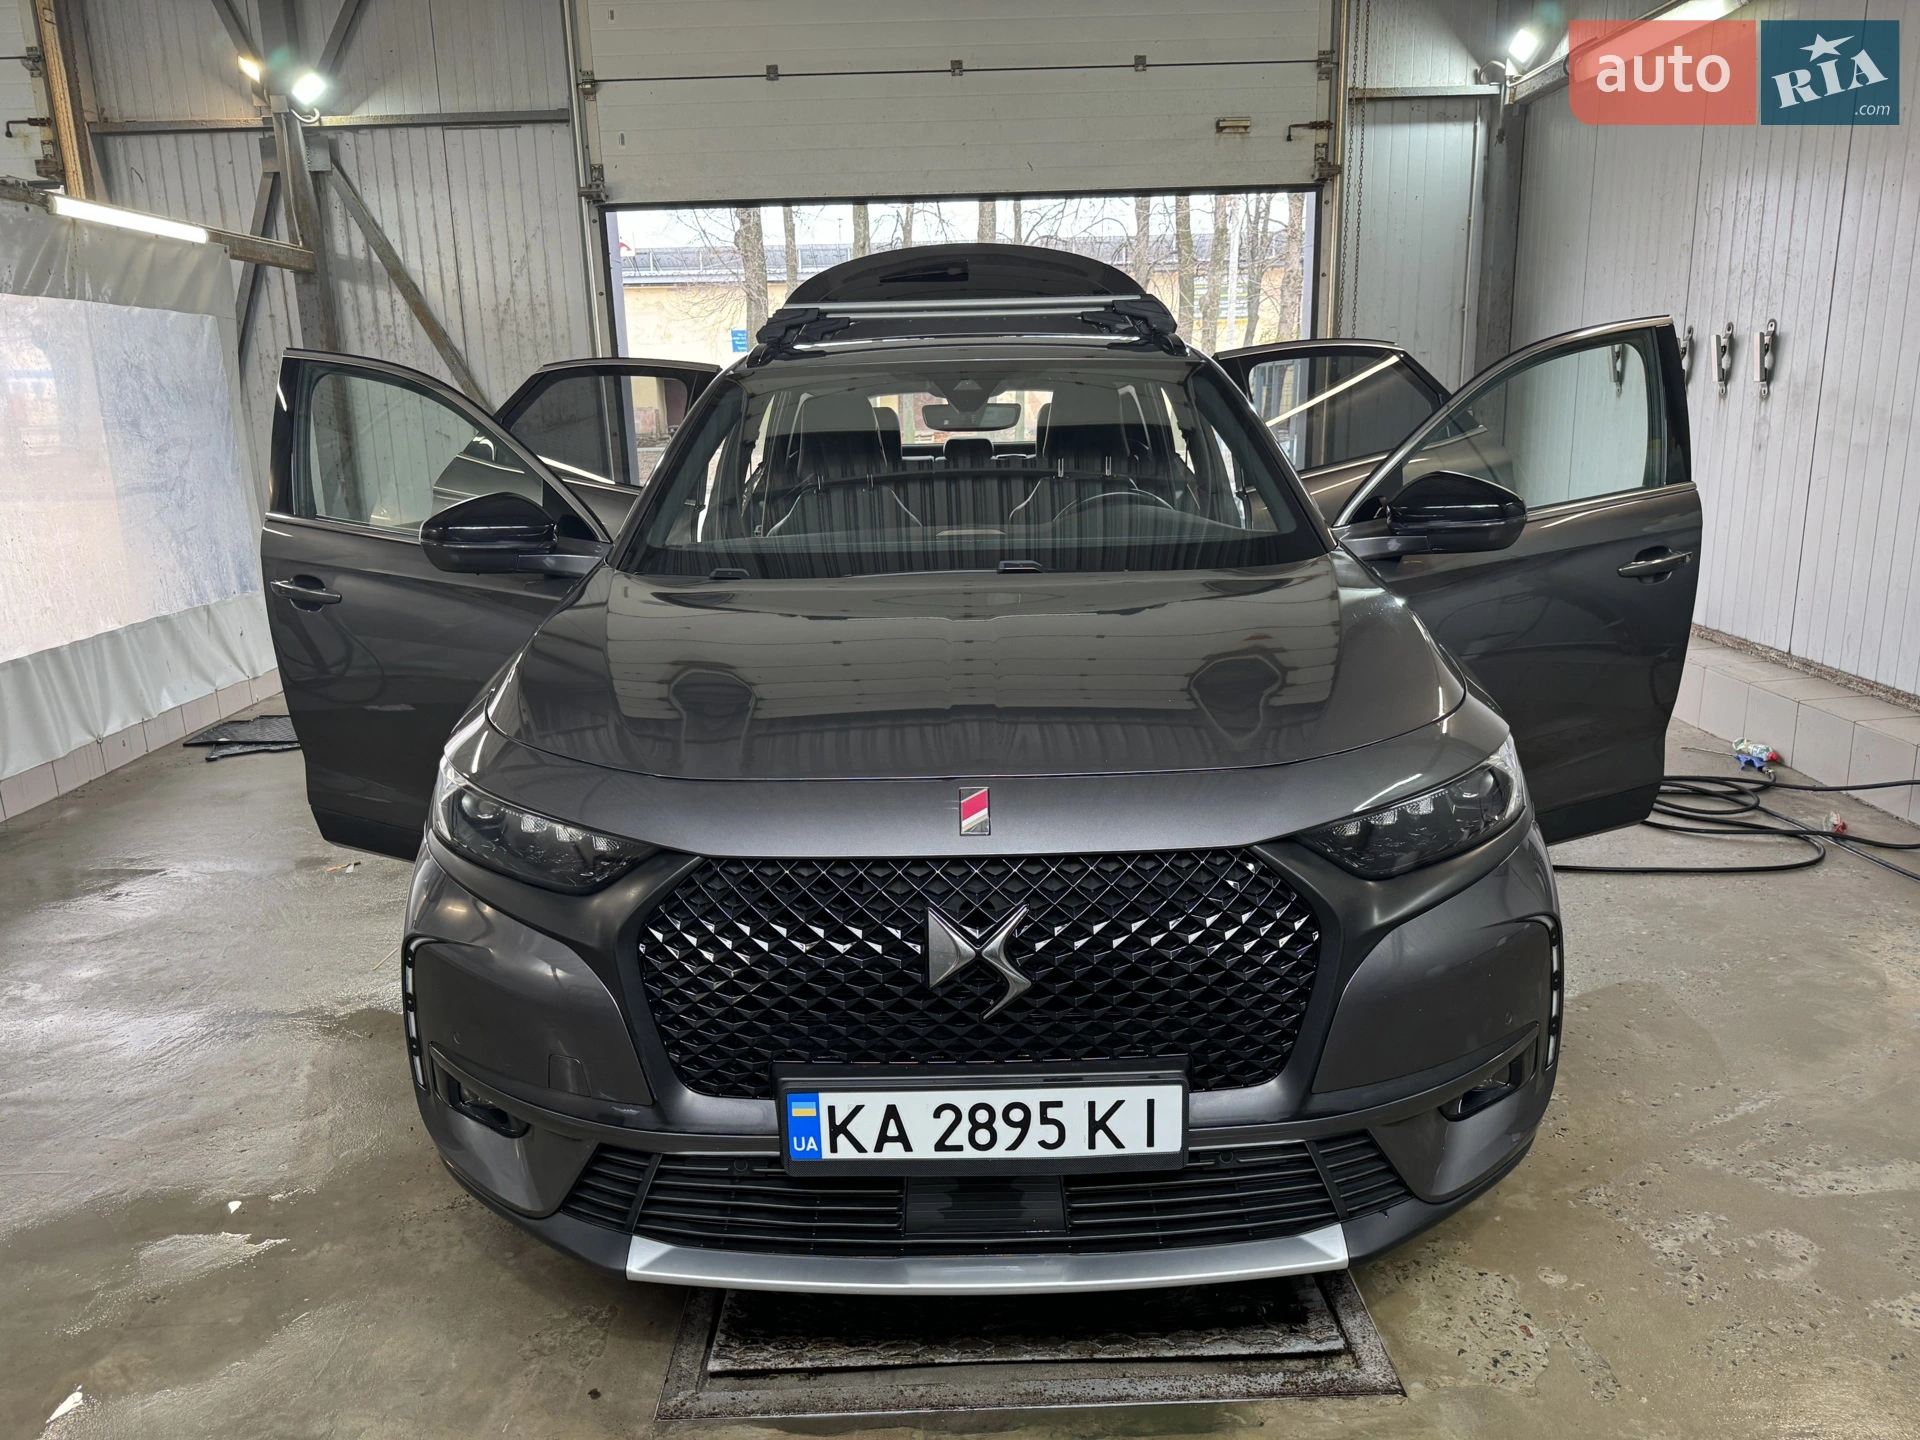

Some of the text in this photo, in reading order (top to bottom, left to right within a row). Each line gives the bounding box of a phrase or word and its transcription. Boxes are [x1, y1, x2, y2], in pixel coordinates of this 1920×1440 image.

[793, 1136, 818, 1152] UA
[826, 1098, 1155, 1154] KA 2895 KI
